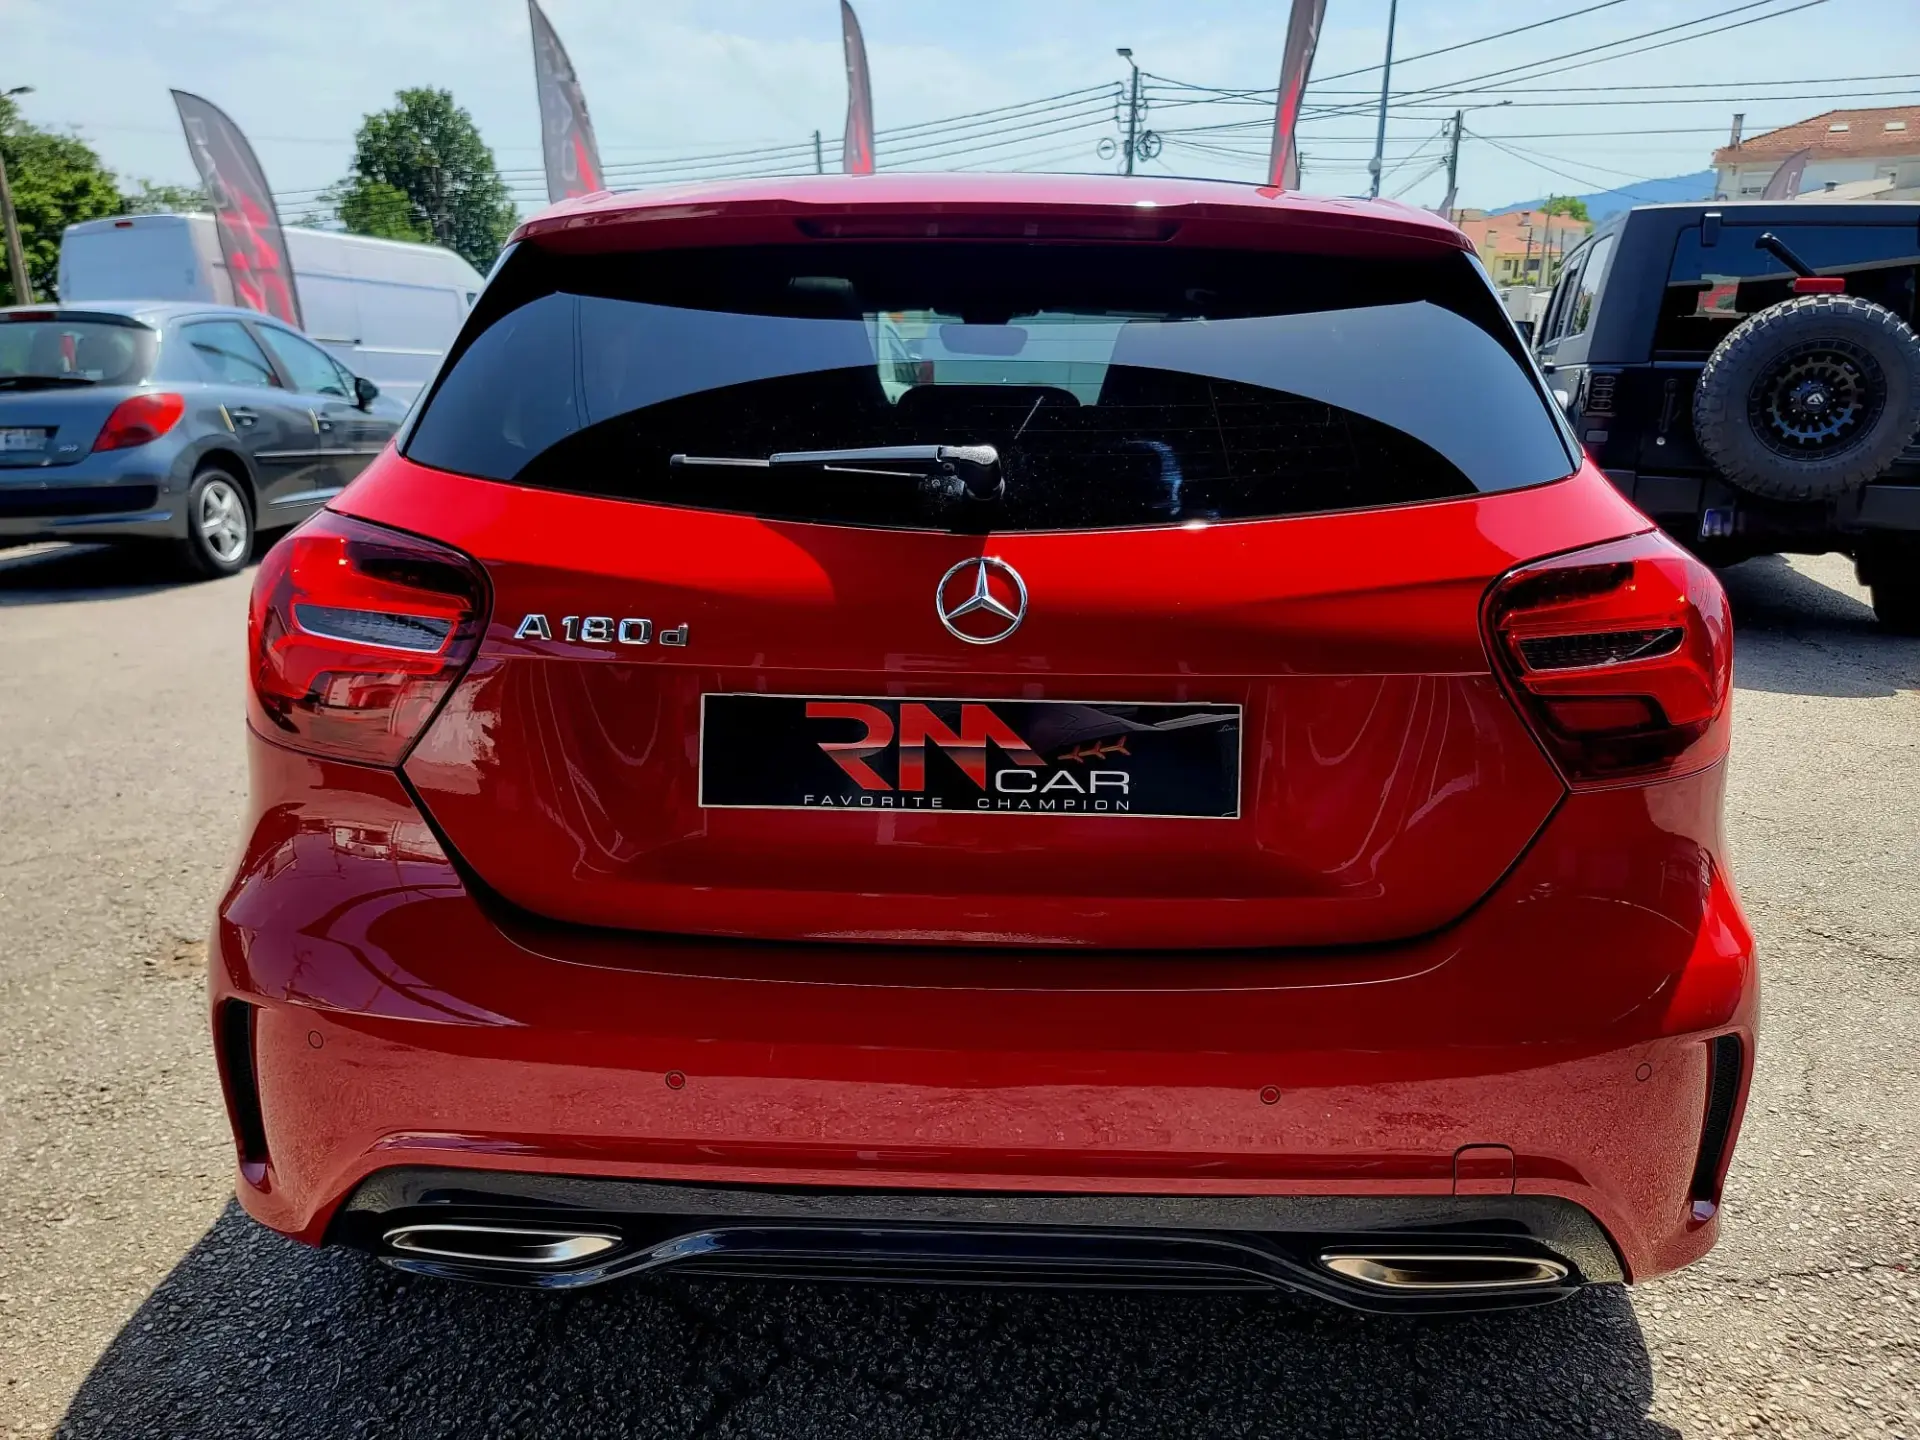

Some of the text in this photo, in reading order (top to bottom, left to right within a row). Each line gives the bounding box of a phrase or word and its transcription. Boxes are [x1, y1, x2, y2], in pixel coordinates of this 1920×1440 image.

[995, 769, 1130, 795] CAR
[803, 794, 1130, 811] FAVORITE CHAMPION
